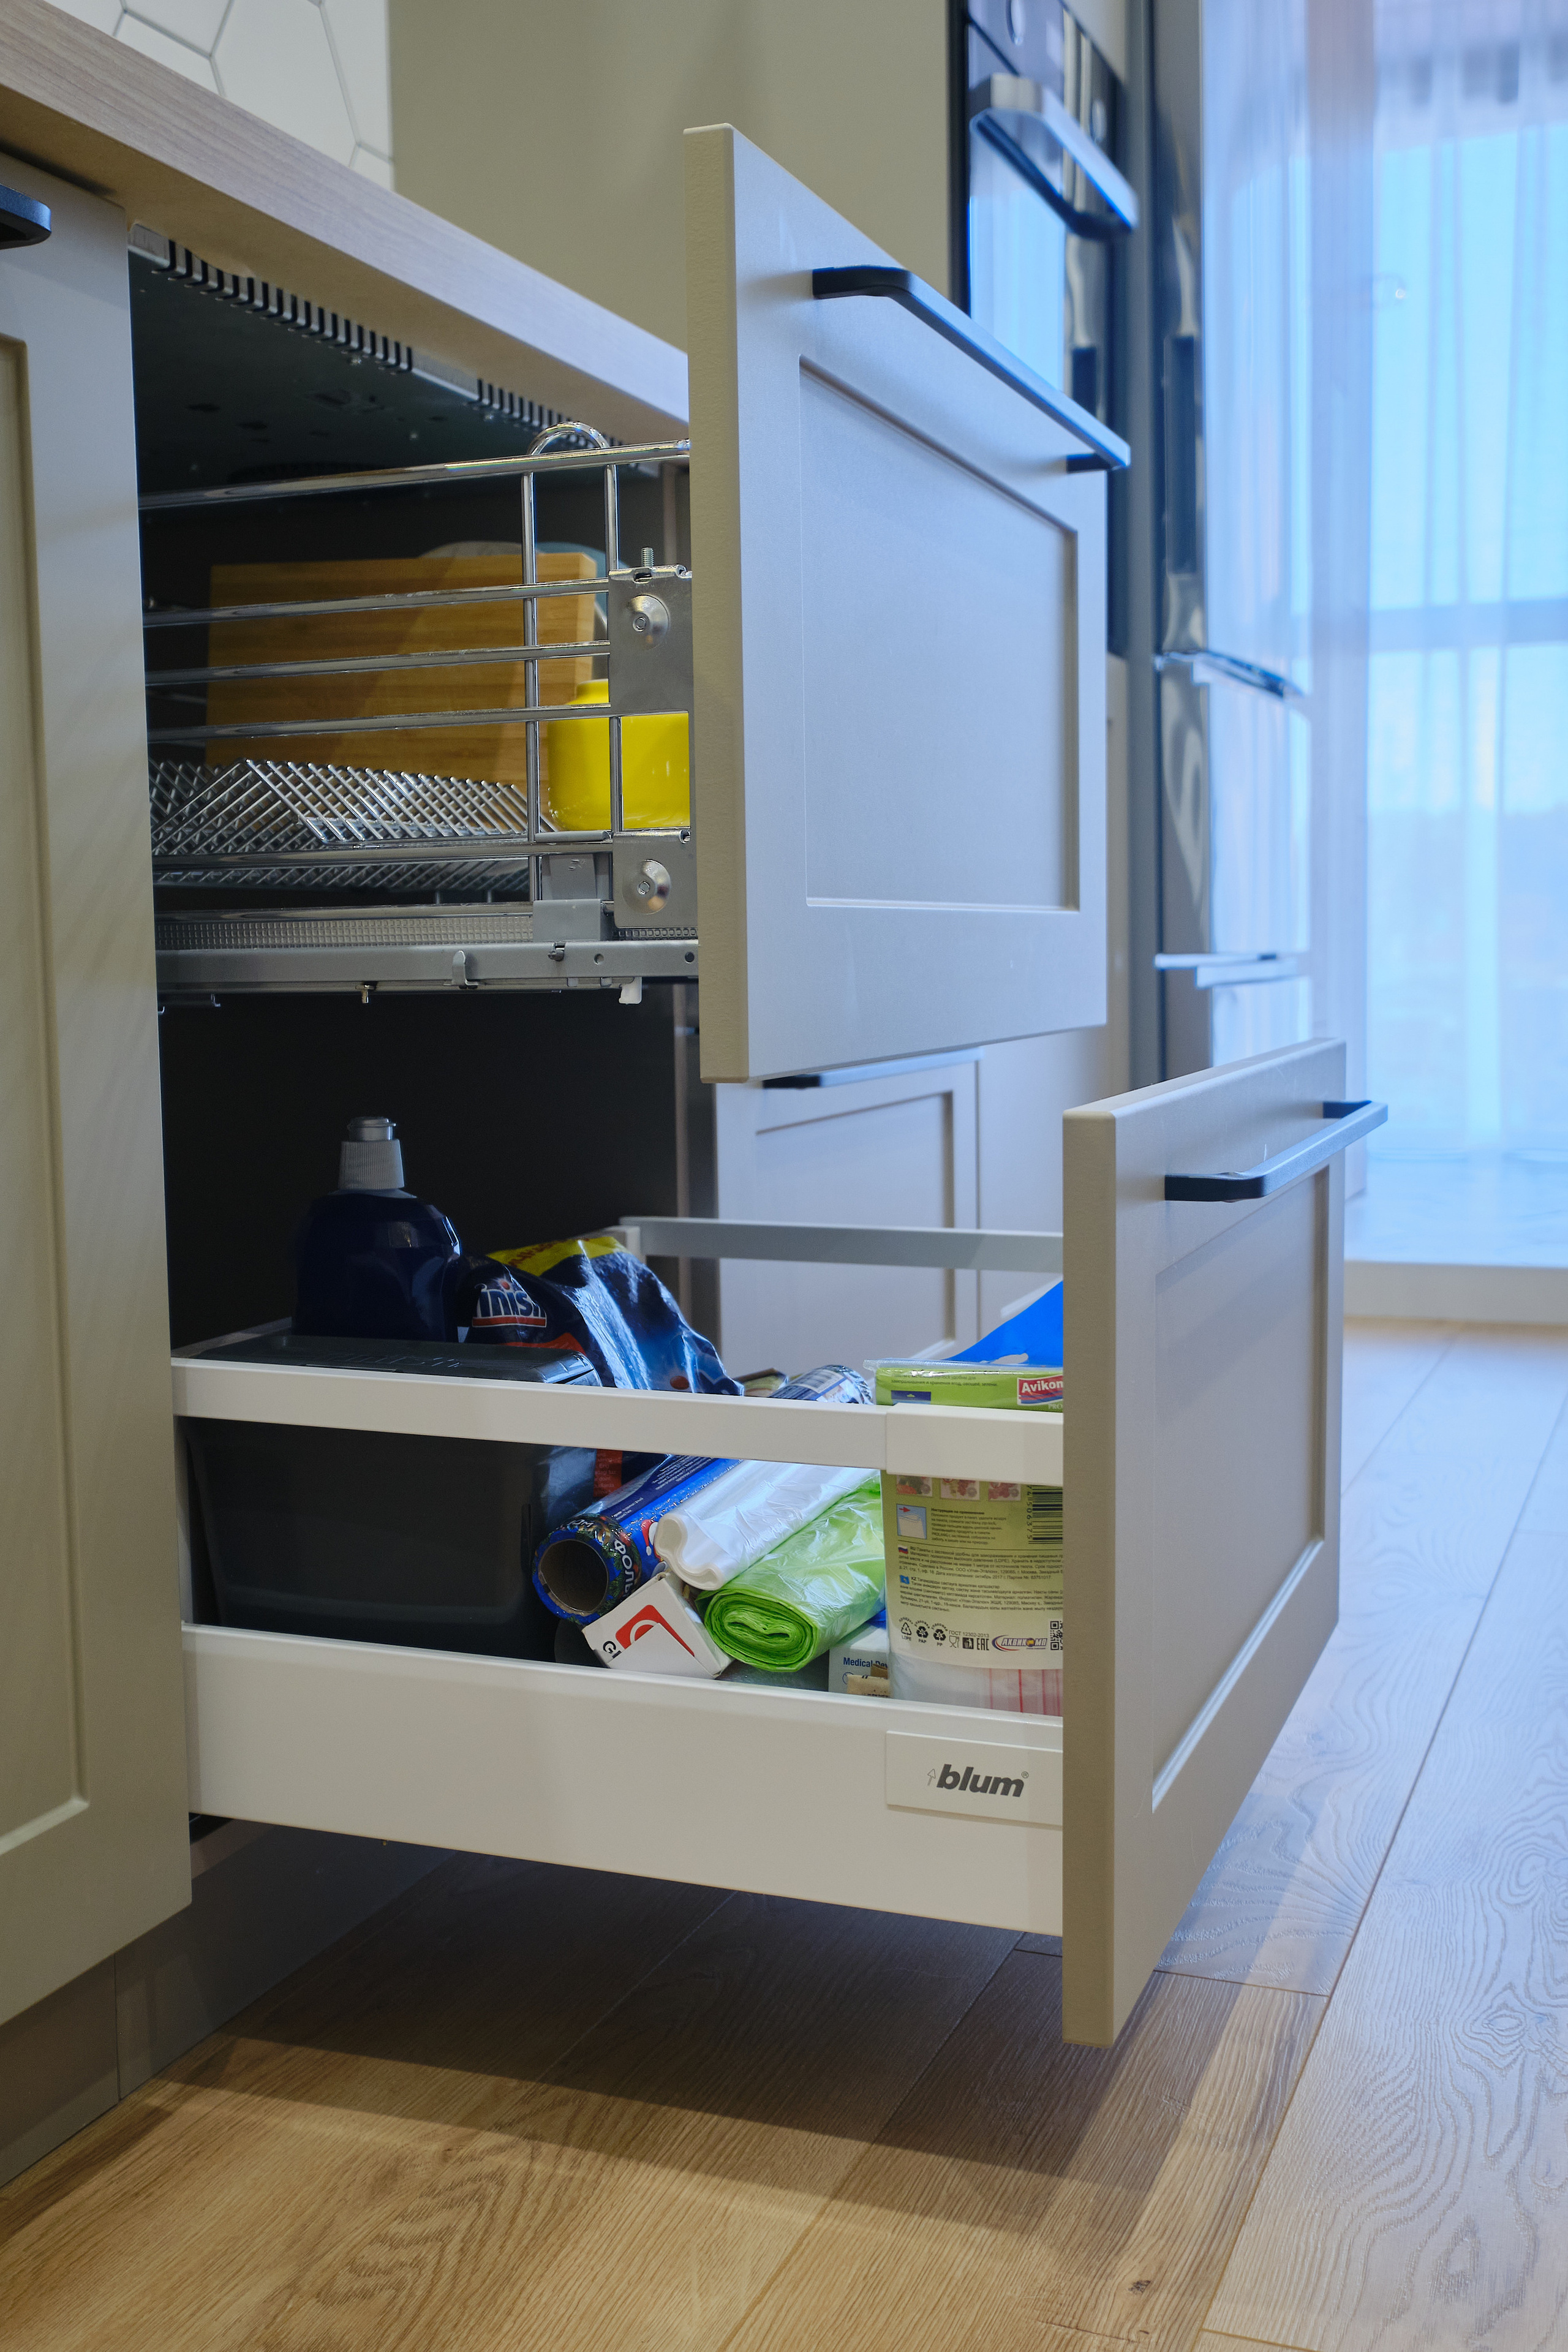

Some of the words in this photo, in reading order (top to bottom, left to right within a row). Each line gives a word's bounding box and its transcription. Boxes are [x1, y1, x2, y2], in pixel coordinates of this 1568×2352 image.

[475, 1280, 547, 1317] inis
[614, 1539, 635, 1598] ФОЛЬ
[843, 1657, 873, 1668] Medical
[936, 1763, 1025, 1797] blum
